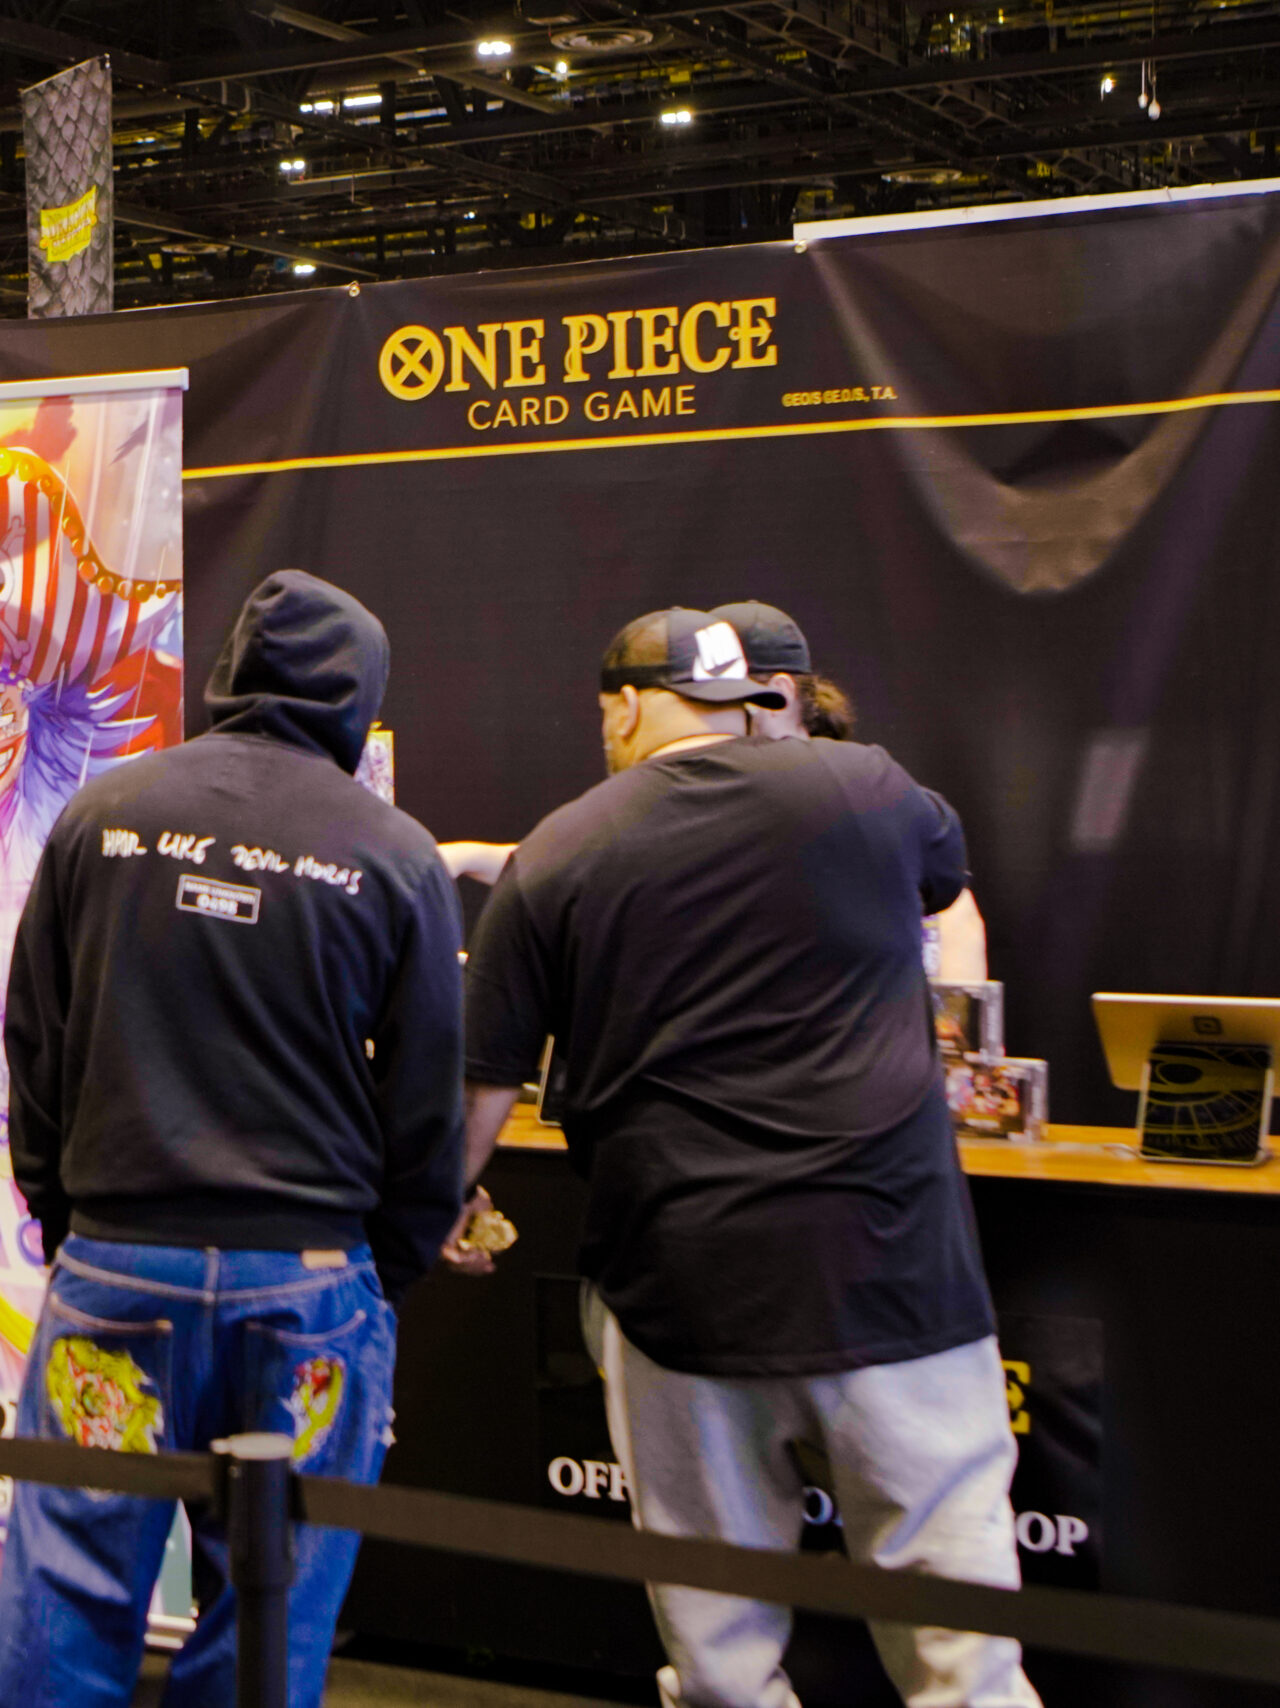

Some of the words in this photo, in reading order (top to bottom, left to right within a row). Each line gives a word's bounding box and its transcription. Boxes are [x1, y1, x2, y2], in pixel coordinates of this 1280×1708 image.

[378, 319, 546, 401] ONE
[562, 297, 778, 383] PIECE
[467, 395, 569, 430] CARD
[584, 385, 696, 421] GAME
